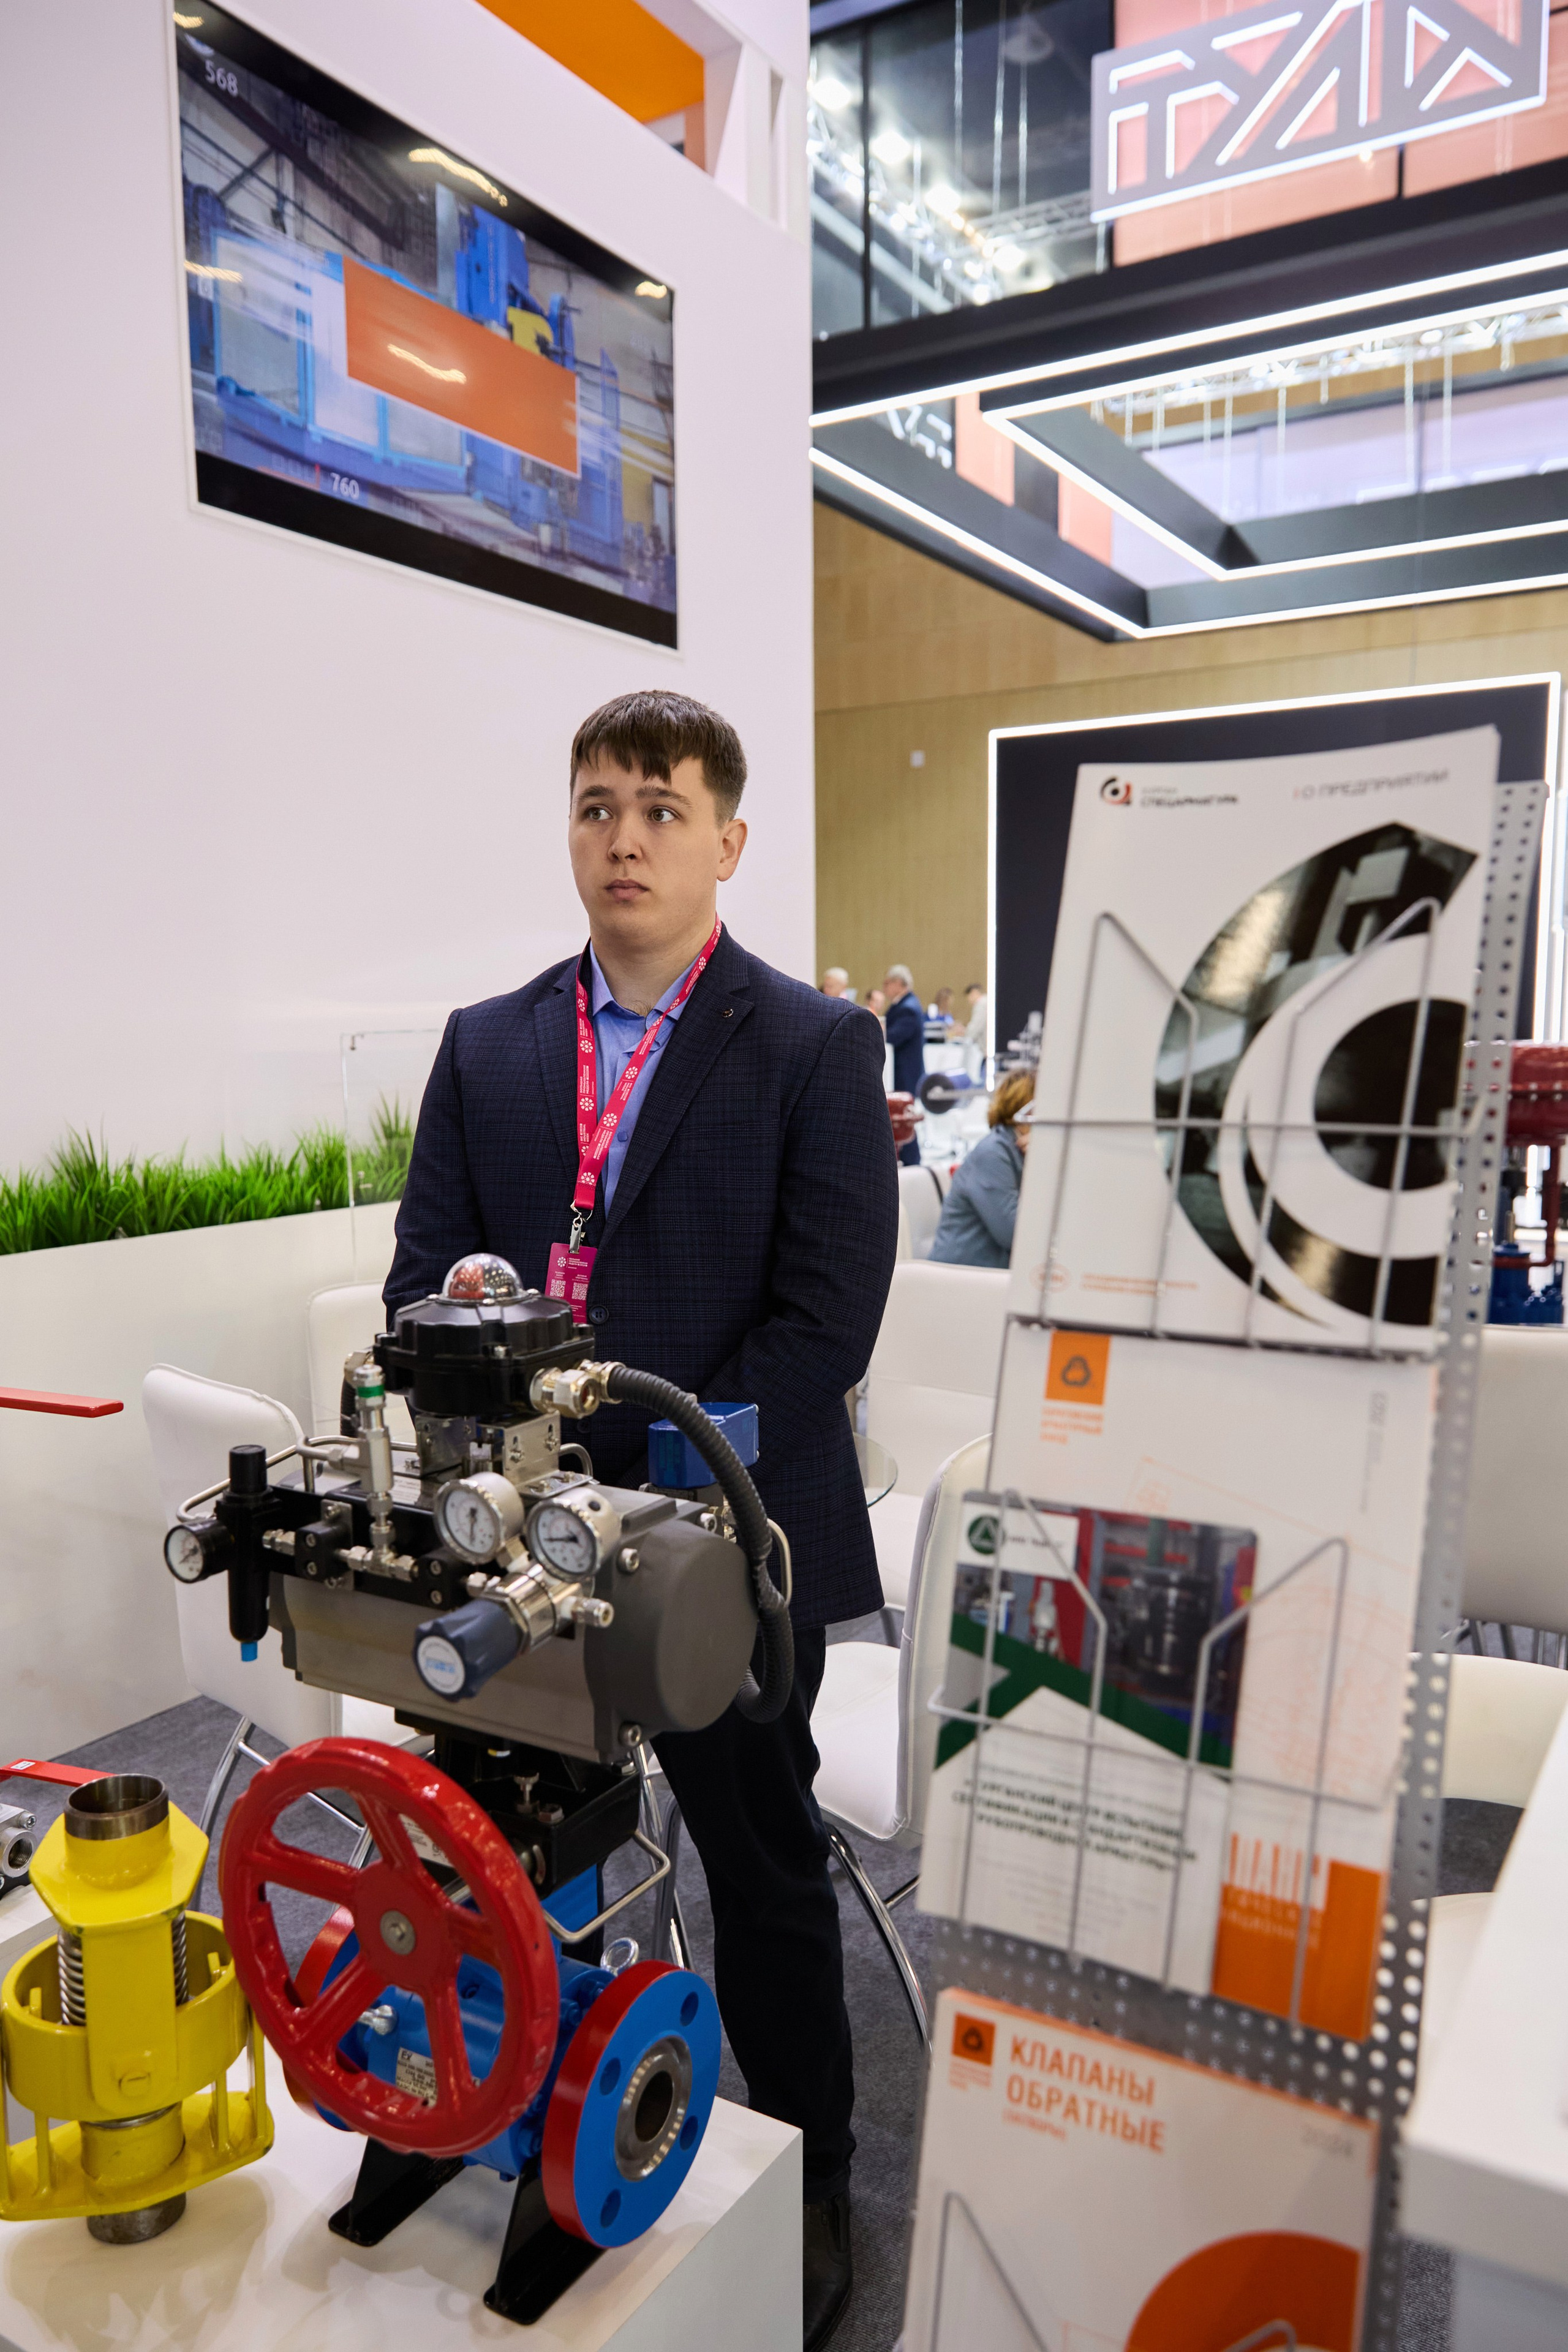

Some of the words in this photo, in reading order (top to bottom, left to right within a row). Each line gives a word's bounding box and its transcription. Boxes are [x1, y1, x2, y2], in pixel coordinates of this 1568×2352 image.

[205, 60, 238, 97] 568
[330, 472, 360, 500] 760
[1011, 2034, 1155, 2108] КЛАПАНЫ
[1006, 2073, 1167, 2155] ОБРАТНЫЕ
